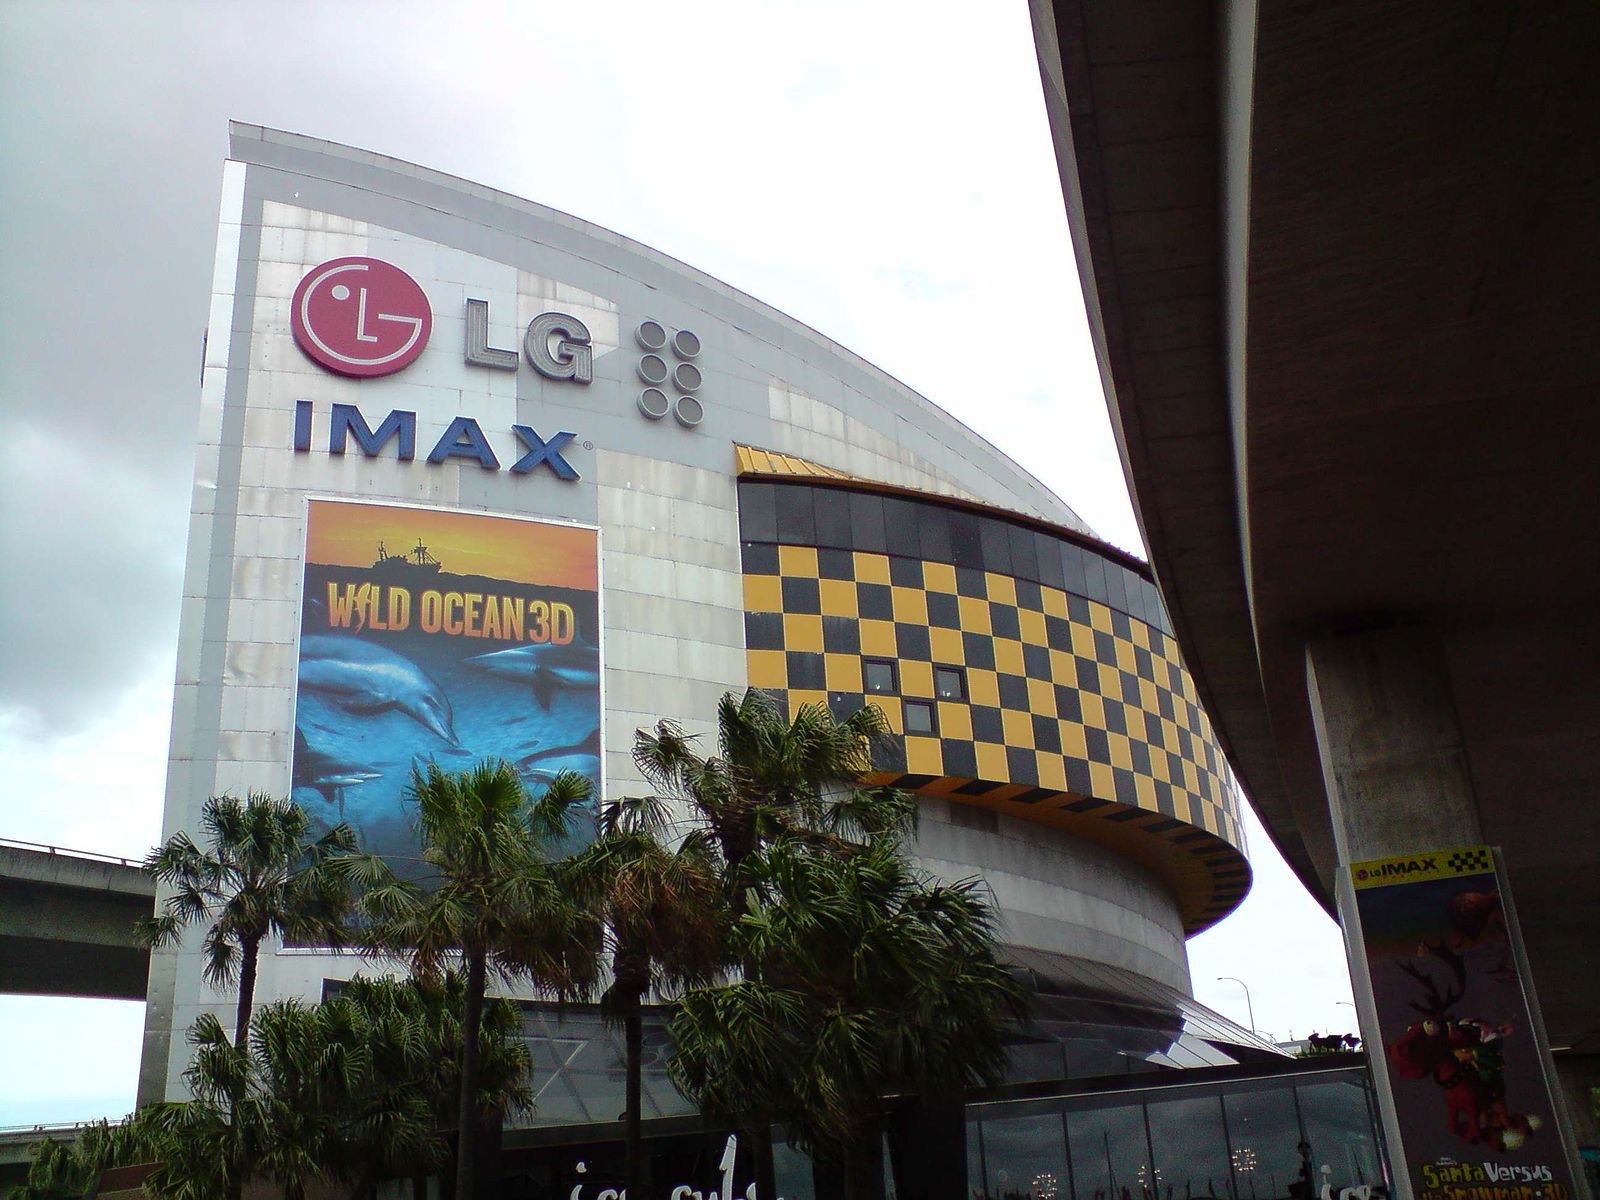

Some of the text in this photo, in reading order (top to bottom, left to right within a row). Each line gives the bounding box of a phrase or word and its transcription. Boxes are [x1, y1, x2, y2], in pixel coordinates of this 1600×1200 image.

[464, 297, 593, 385] LG
[327, 581, 576, 646] WILD OCEAN 3D
[1381, 859, 1438, 876] IMAX
[1423, 1162, 1553, 1189] Santa Versus
